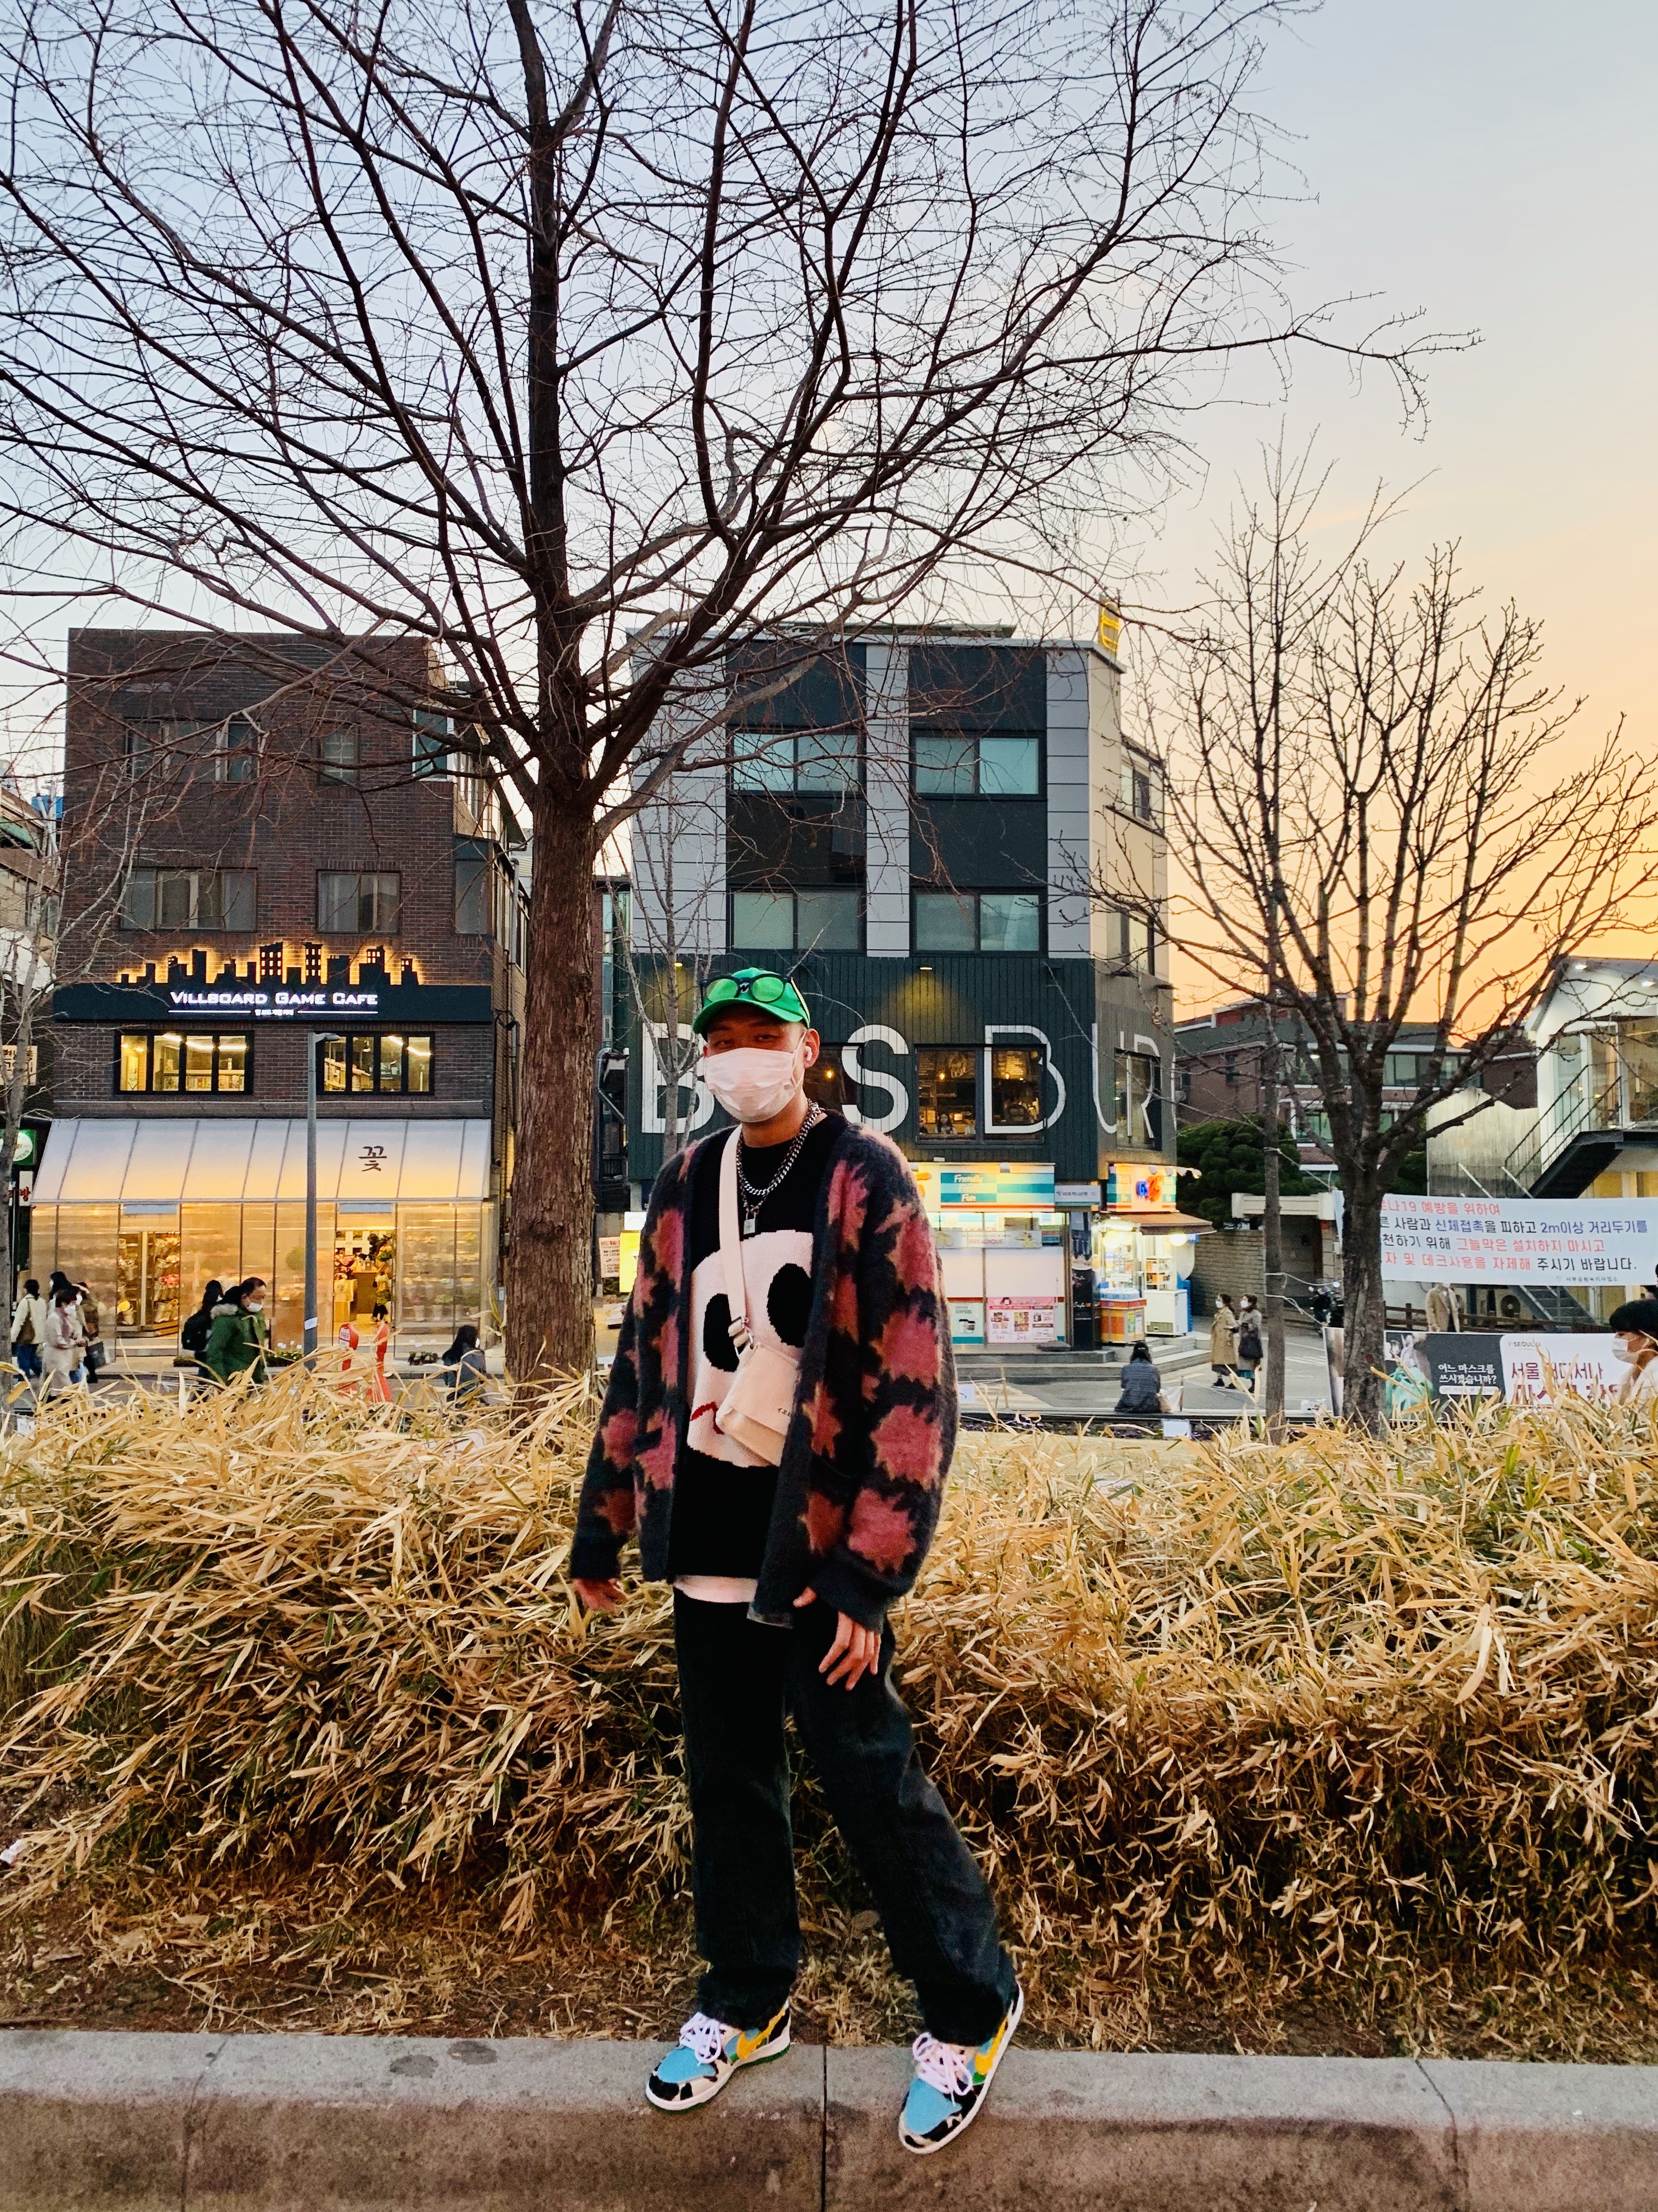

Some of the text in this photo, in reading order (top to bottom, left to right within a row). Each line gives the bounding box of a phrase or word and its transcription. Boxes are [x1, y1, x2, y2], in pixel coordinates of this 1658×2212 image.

[275, 992, 326, 1005] GAME
[332, 993, 379, 1005] CAFE
[642, 1023, 909, 1133] BS
[358, 1146, 387, 1171] 꽃
[961, 1194, 977, 1202] Fun
[1422, 1201, 1459, 1215] 예방을
[1464, 1203, 1501, 1216] 위하여
[1395, 1217, 1431, 1231] 사람과
[1435, 1218, 1497, 1233] 신체접촉을
[1501, 1221, 1537, 1234] 피하고
[1540, 1221, 1584, 1234] 2m이상
[1588, 1220, 1648, 1234] 거리두기를
[1426, 1237, 1451, 1250] 위해
[1457, 1238, 1508, 1252] 그늘막은
[1513, 1239, 1562, 1252] 설치하지
[1567, 1239, 1605, 1252] 마시고
[1403, 1252, 1415, 1266] 및
[1422, 1254, 1487, 1270] 데크사용을
[1492, 1256, 1531, 1271] 자제해
[1537, 1258, 1575, 1271] 주시기
[1581, 1257, 1637, 1271] 바랍니다.
[1438, 1363, 1496, 1374] 어느 마스크를
[1439, 1374, 1497, 1385] 쓰시겠습니까?
